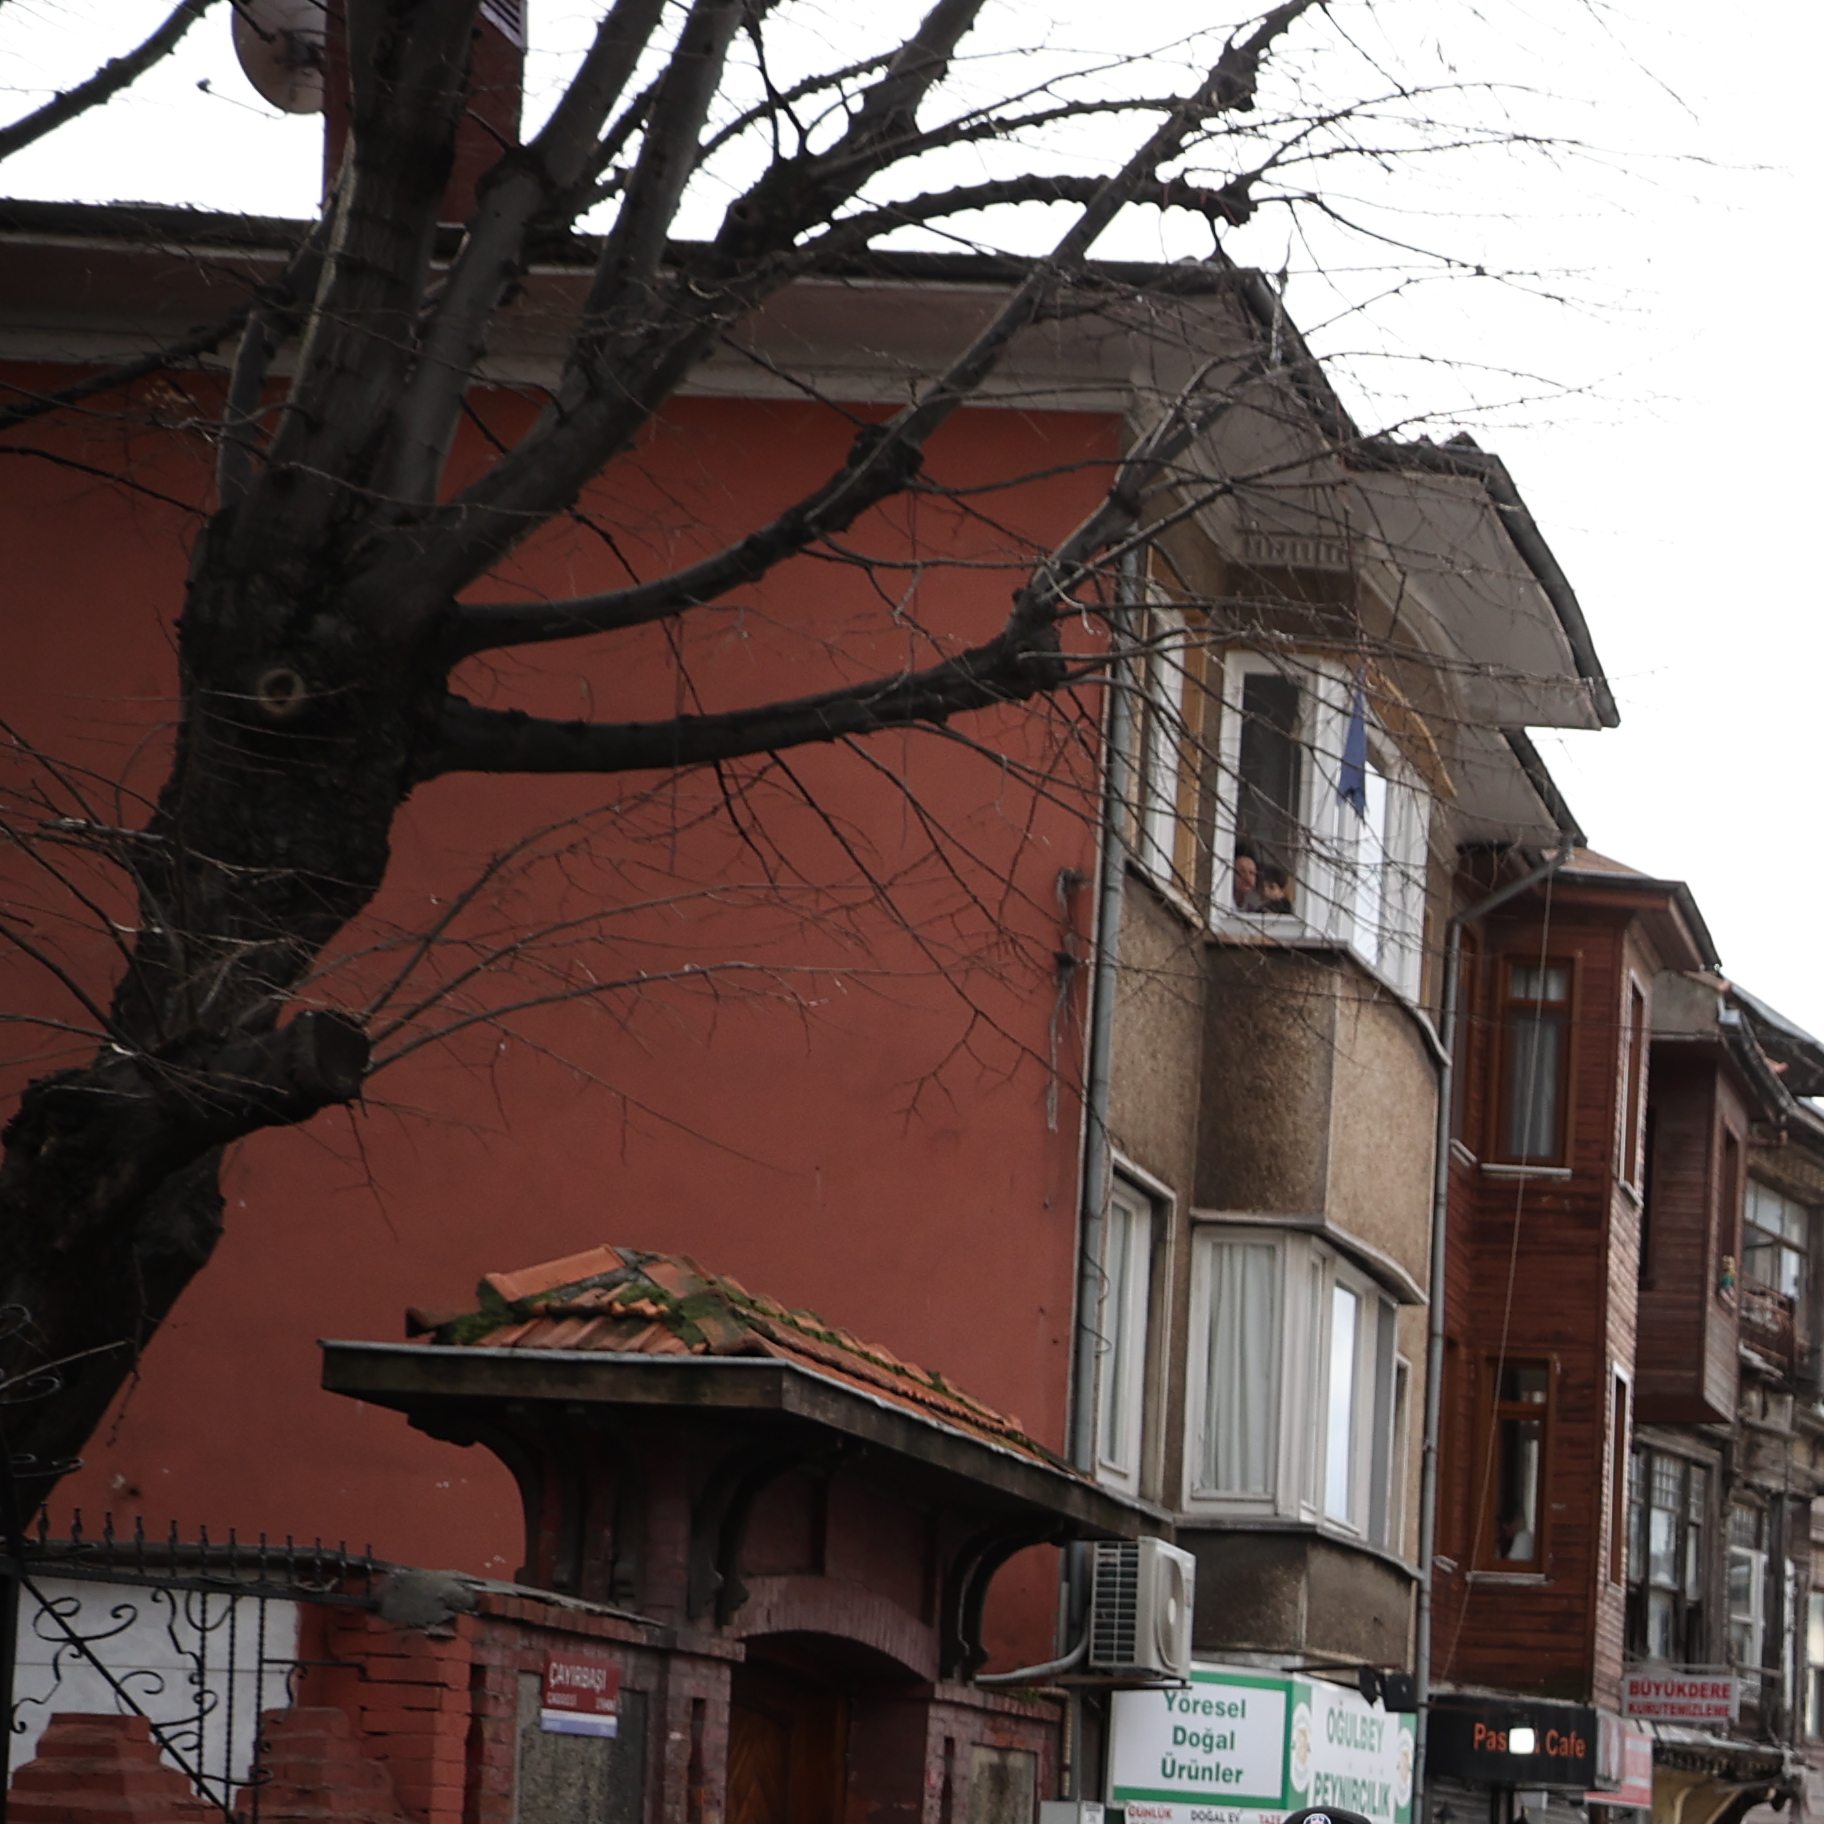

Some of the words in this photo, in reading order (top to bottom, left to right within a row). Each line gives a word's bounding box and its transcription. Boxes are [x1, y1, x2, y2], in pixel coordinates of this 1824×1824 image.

[1163, 1689, 1247, 1719] Yöresel
[1629, 1679, 1732, 1700] BÜYÜKDERE
[1172, 1725, 1236, 1753] Doğal
[1327, 1700, 1386, 1754] OĞULBEY
[1545, 1728, 1587, 1759] Cafe
[1161, 1752, 1244, 1785] Ürünler
